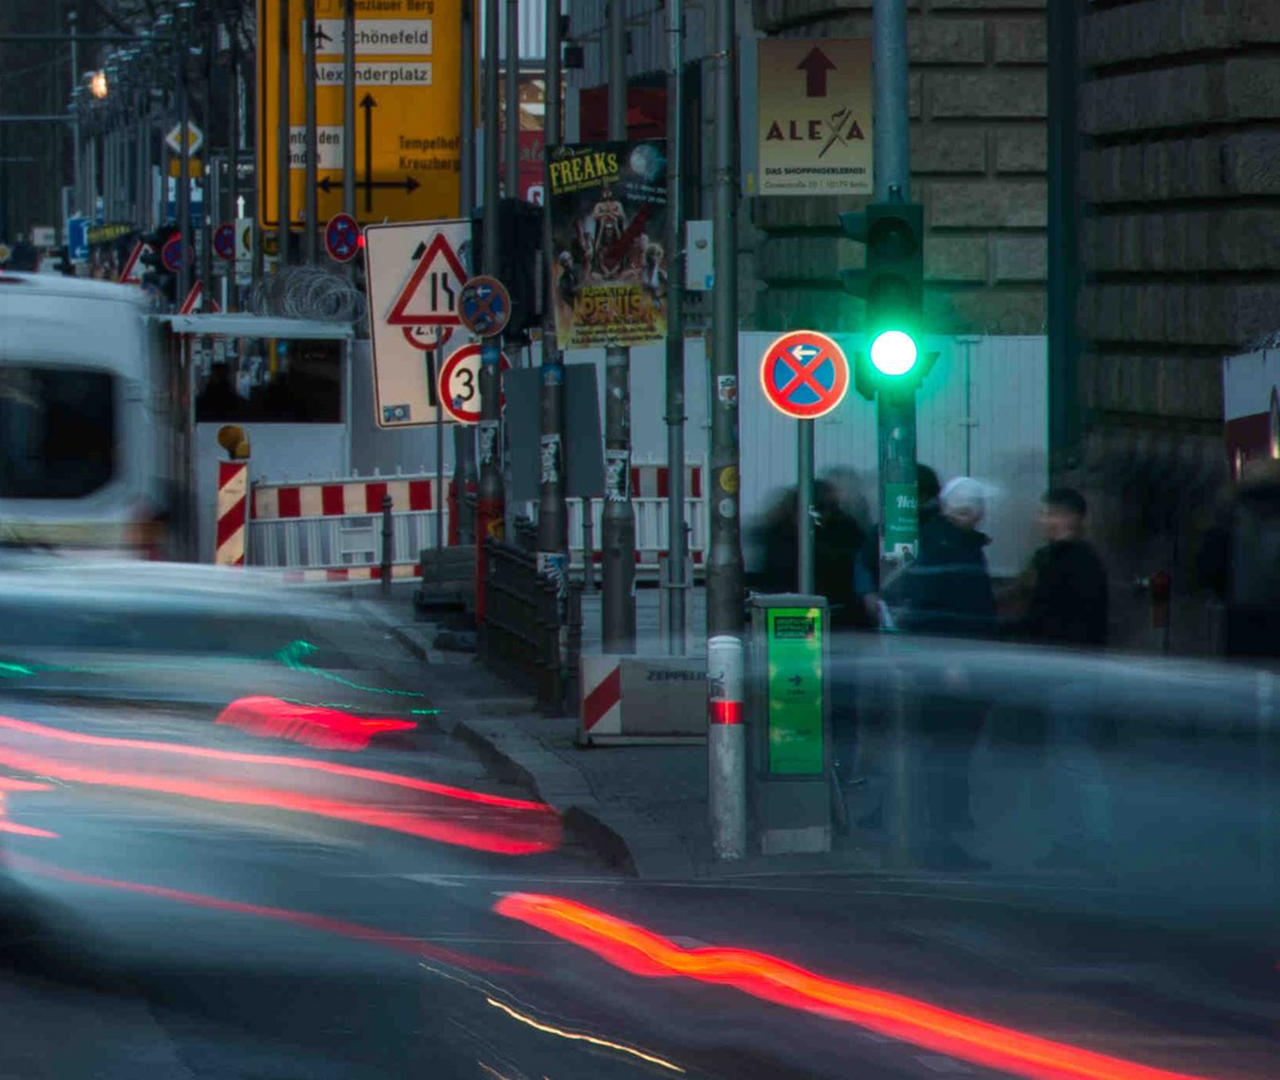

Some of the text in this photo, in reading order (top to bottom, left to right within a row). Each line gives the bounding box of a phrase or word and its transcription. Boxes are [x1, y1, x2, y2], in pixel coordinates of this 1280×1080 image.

[314, 67, 428, 85] Alexnderplatz
[318, 130, 340, 144] den
[766, 105, 865, 159] ALEXA
[549, 151, 620, 188] FREAKS
